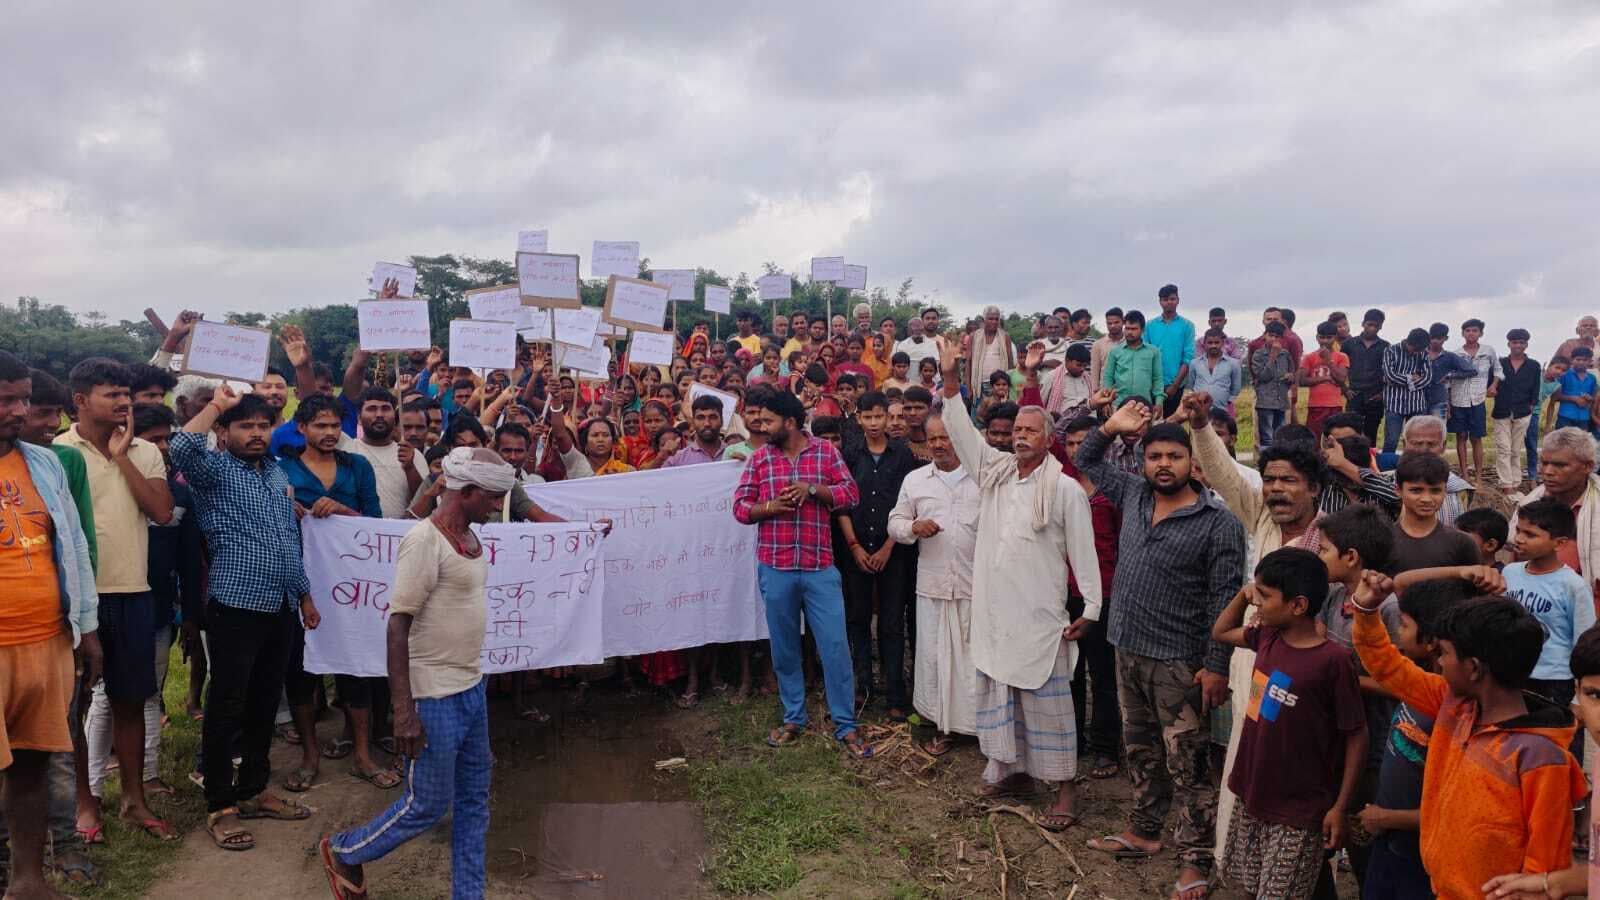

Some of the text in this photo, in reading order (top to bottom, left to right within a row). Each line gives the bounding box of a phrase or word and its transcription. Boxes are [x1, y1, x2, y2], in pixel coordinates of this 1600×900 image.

[519, 534, 555, 563] 79
[1525, 592, 1552, 614] CLUB
[1269, 684, 1299, 708] ESS
